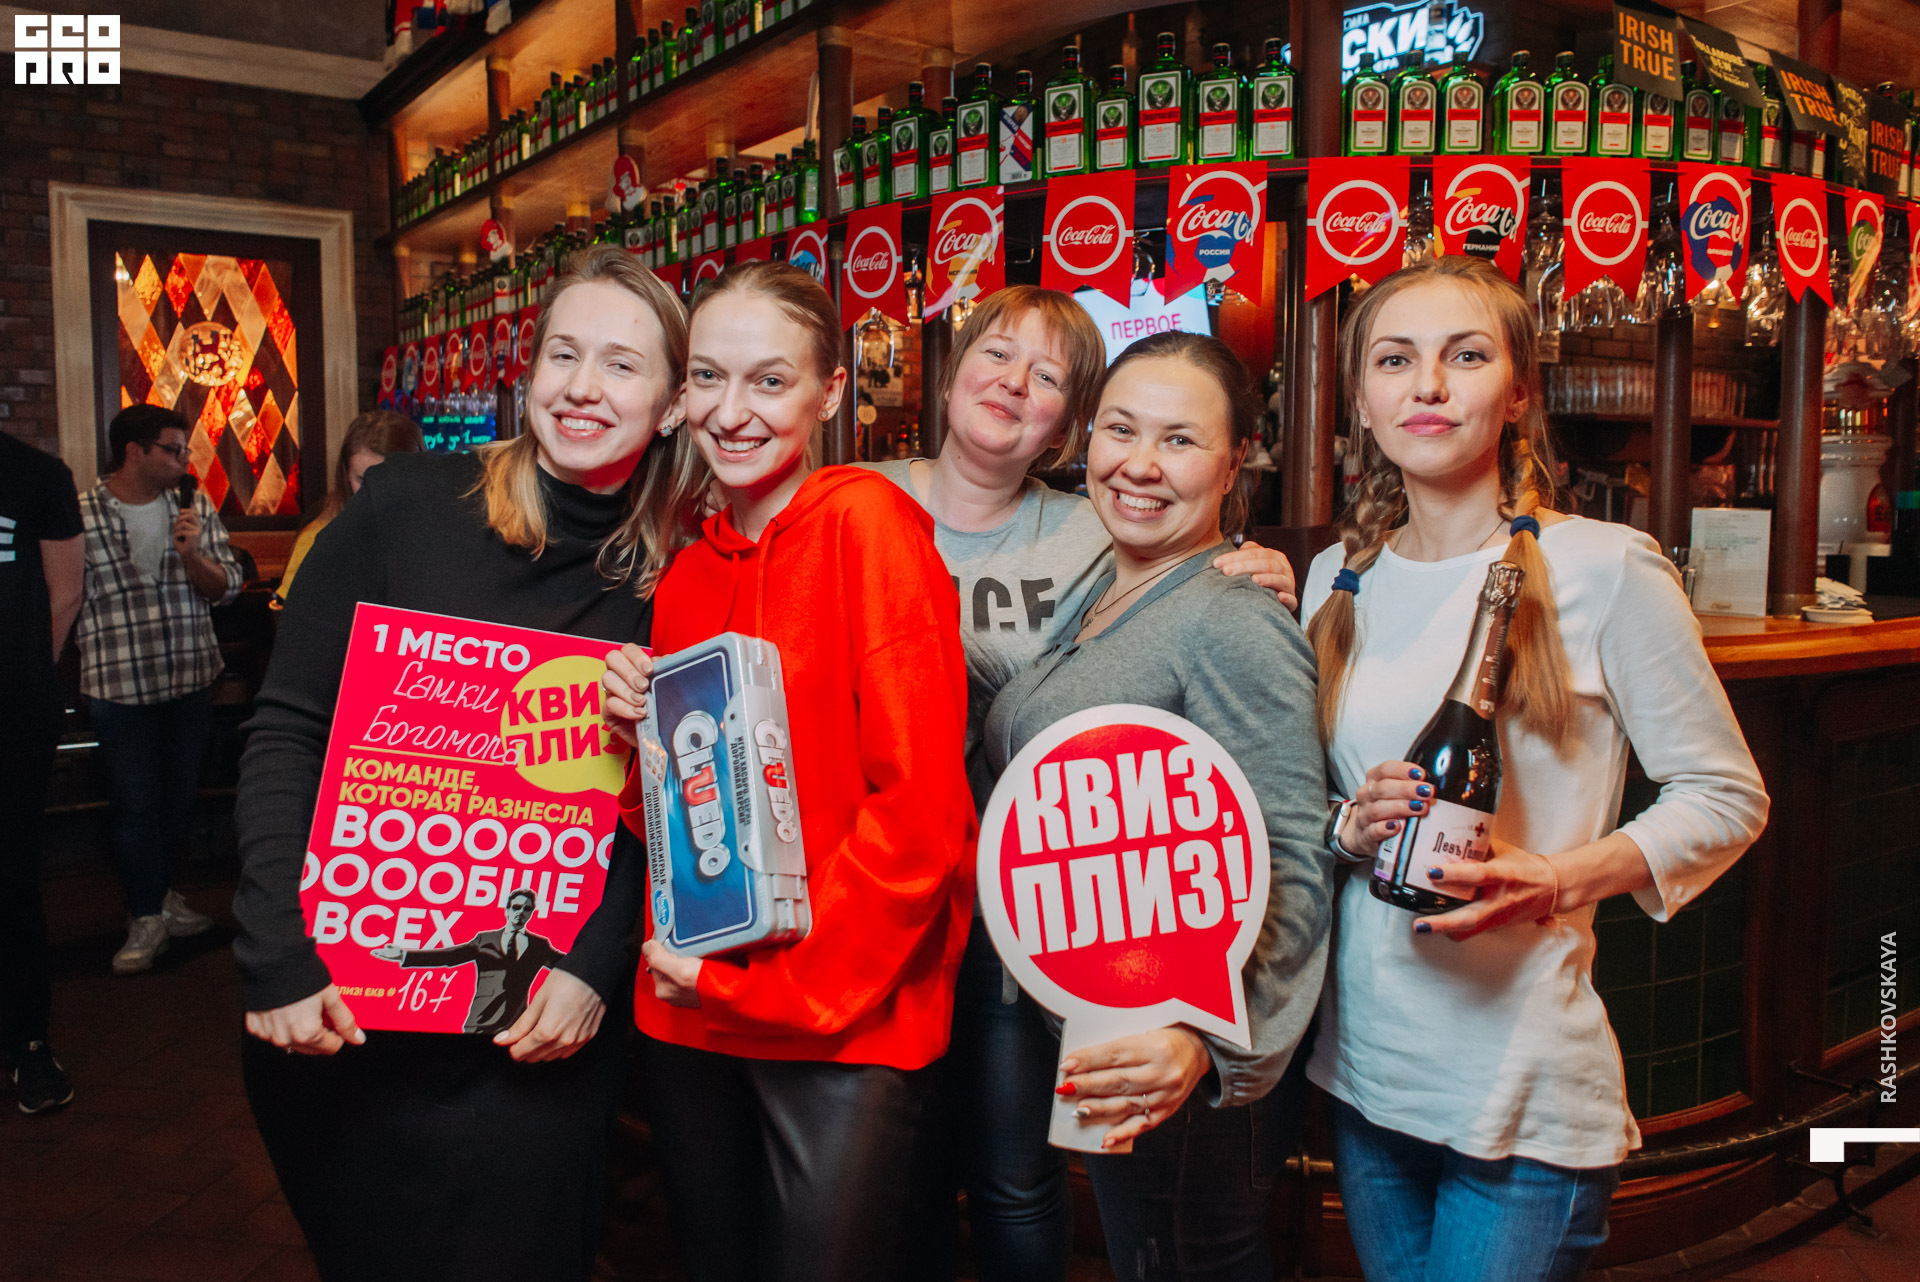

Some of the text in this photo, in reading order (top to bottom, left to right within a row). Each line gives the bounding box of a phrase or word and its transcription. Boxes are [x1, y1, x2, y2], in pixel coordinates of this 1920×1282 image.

[1619, 12, 1674, 55] IRISH
[1620, 39, 1677, 81] TRUE
[1780, 69, 1833, 105] IRISH
[1790, 93, 1843, 127] TRUE
[1871, 120, 1905, 154] IRISH
[1058, 224, 1117, 246] Coca-Cola
[1326, 211, 1387, 233] Coca-Cola
[1580, 211, 1634, 235] Coca-Cola
[1785, 226, 1817, 249] Coca-Cola
[852, 251, 890, 273] Coca-Cola
[1462, 243, 1500, 252] ГЕРМАНИЯ
[1111, 313, 1182, 341] ПЕРВОЕ
[373, 624, 531, 673] 1 МЕСТО
[393, 660, 500, 714] Самки
[505, 681, 602, 726] КВИ
[343, 756, 481, 795] КОМАНДЕ,
[672, 710, 732, 877] CLUEDO
[737, 736, 746, 760] ИГРЫ
[744, 797, 752, 825] СЕРИЯ
[754, 719, 798, 843] CLUEDO
[339, 781, 594, 827] КОТОРАЯ РАЗНЕСЛА
[652, 785, 661, 820] ПОЛНАЯ
[1015, 742, 1234, 856] КВИЗ,
[645, 792, 660, 883] ДОРОЖНОМ ВАРИАНТЕ
[655, 820, 664, 853] ВЕРСИЯ
[658, 854, 667, 878] ИГРЫ
[1011, 834, 1250, 956] ПЛИЗ!
[312, 901, 465, 951] ВСЕХ
[336, 971, 458, 1014] ЛИЗ! ЕКВ # 167
